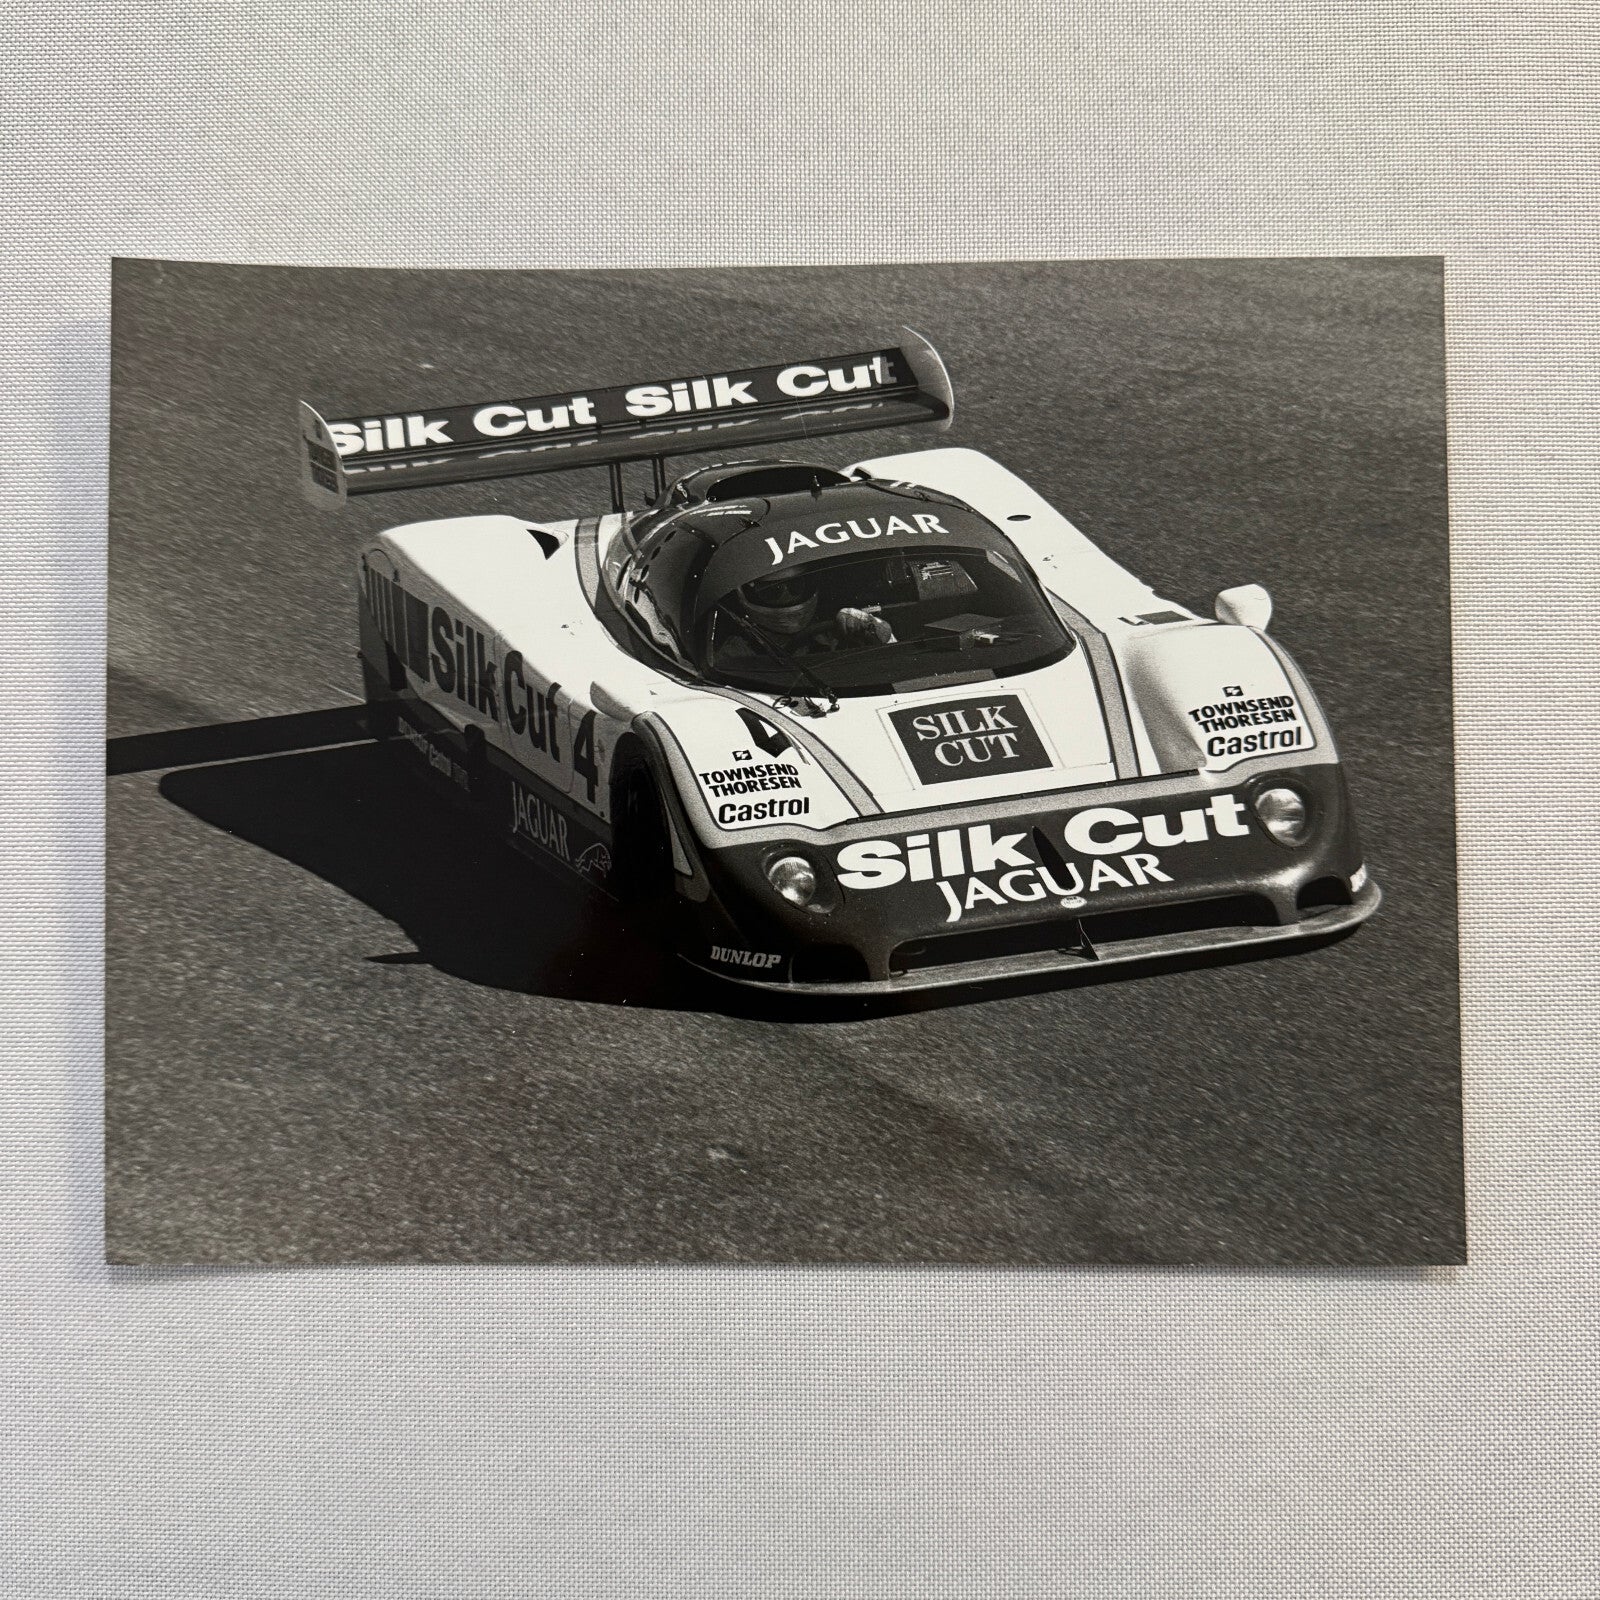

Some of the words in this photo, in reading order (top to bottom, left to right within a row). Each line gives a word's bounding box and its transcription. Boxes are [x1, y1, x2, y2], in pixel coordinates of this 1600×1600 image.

[328, 414, 452, 457] Silk
[473, 396, 597, 437] Cut
[625, 375, 758, 418] Silk
[776, 354, 898, 398] Cut
[765, 513, 949, 566] JAGUAR
[430, 605, 499, 723] Silk
[503, 649, 562, 764] Cut
[573, 709, 599, 804] 4
[1188, 695, 1295, 721] TOWNSEND
[1198, 708, 1297, 734] THORESEN
[912, 705, 1018, 742] SILK
[934, 732, 1020, 768] CUT
[1206, 726, 1302, 758] Castrol
[699, 763, 799, 786] TOWNSEND
[708, 777, 802, 798] THORESEN
[509, 781, 570, 861] JAGUAR
[717, 797, 810, 825] Castrol
[836, 824, 1036, 891] Silk
[1063, 793, 1250, 856] Cut
[936, 853, 1175, 923] JAGUAR
[710, 945, 782, 970] DUNLOP
